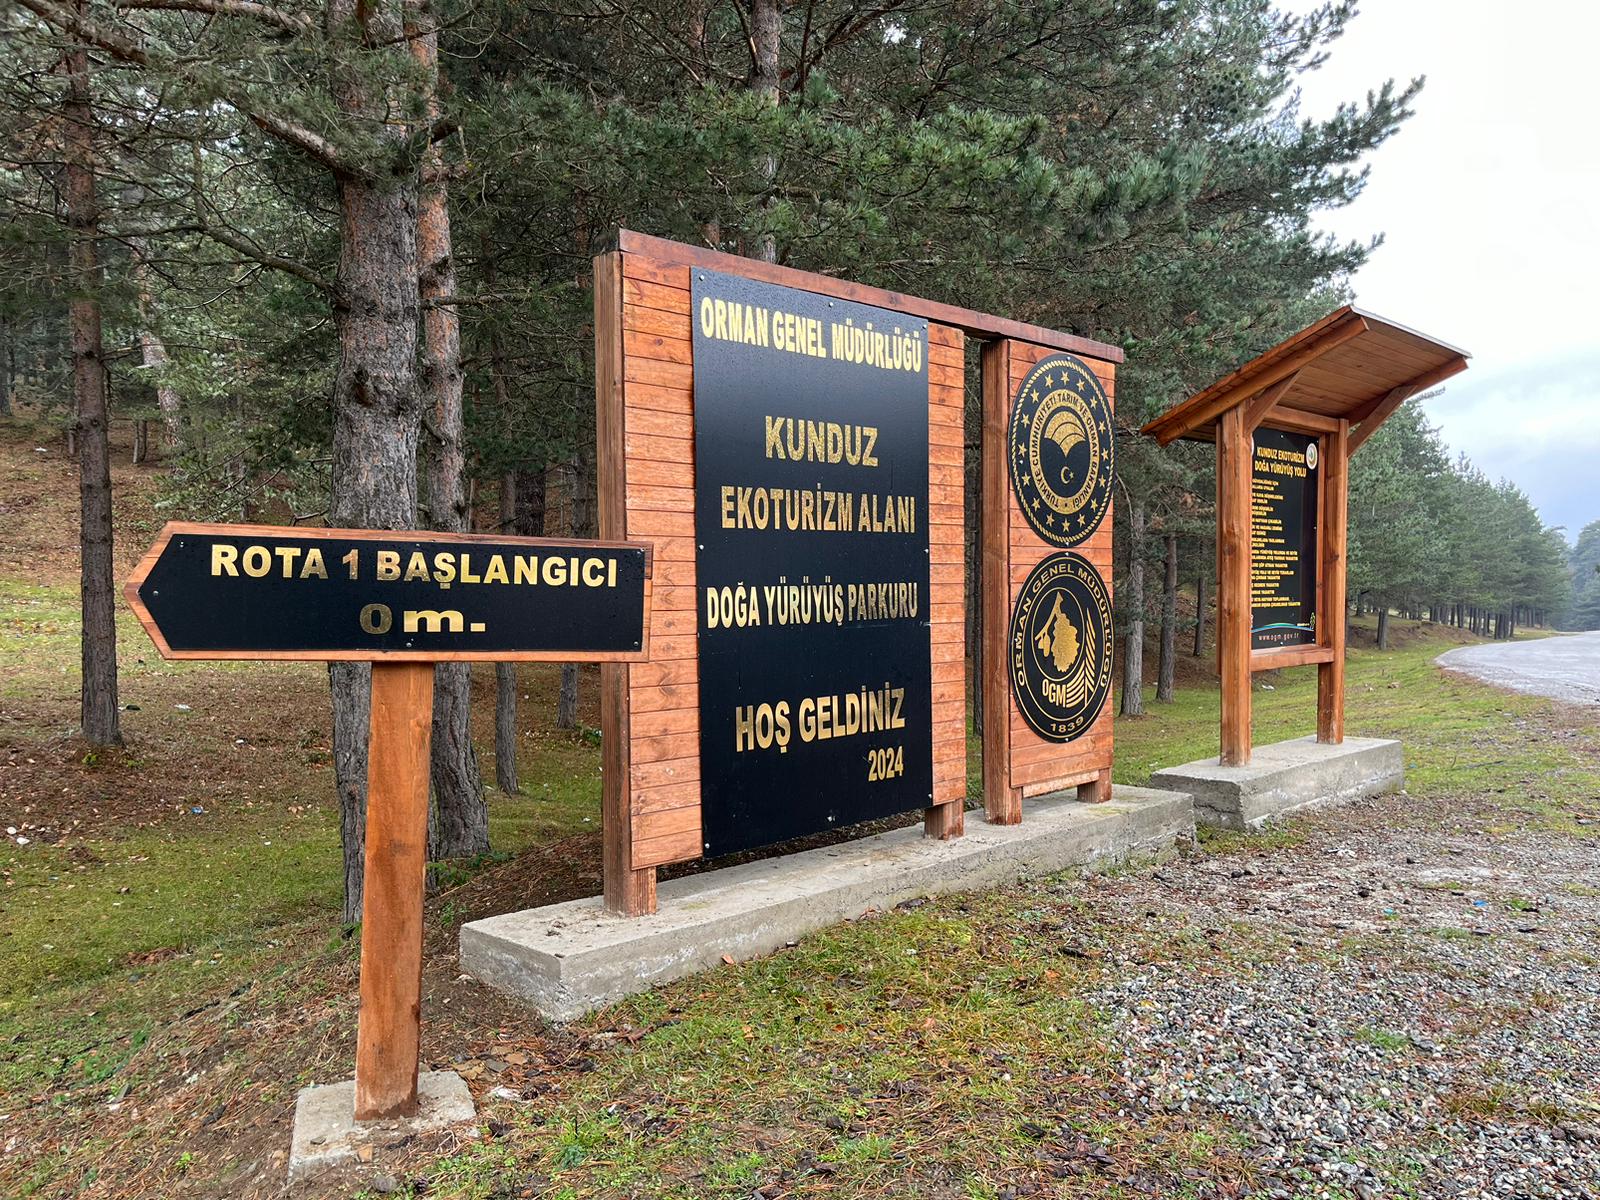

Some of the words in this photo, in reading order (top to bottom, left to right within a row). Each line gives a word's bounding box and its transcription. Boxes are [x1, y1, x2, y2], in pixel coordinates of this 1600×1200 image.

[700, 297, 769, 348] ORMAN
[772, 310, 827, 359] GENEL
[831, 317, 922, 373] MÜDÜRLÜĞÜ
[765, 415, 879, 468] KUNDUZ
[1086, 416, 1099, 458] ORMAN
[1256, 446, 1278, 460] KUNDUZ
[1254, 459, 1270, 473] DOĞA
[1269, 461, 1294, 478] YÜRÜYÜŞ
[1293, 466, 1308, 478] YOLU
[721, 482, 853, 532] EKOTURİZM
[858, 493, 916, 534] ALANI
[210, 543, 329, 580] ROTA
[341, 548, 360, 580] 1
[376, 549, 618, 589] BAŞLANGICI
[402, 609, 487, 633] m.
[706, 581, 761, 629] DOĞA
[764, 575, 844, 627] YÜRÜYÜŞ
[848, 582, 919, 622] PARKURU
[1015, 598, 1032, 688] ORMAN
[1032, 563, 1075, 593] GENEL
[1077, 566, 1113, 688] MÜDÜRLÜĞÜ
[1041, 678, 1067, 708] OGM
[735, 700, 791, 754] HOŞ
[798, 681, 906, 743] GELDİNİZ
[1050, 715, 1085, 734] 1839
[868, 746, 904, 782] 2024
